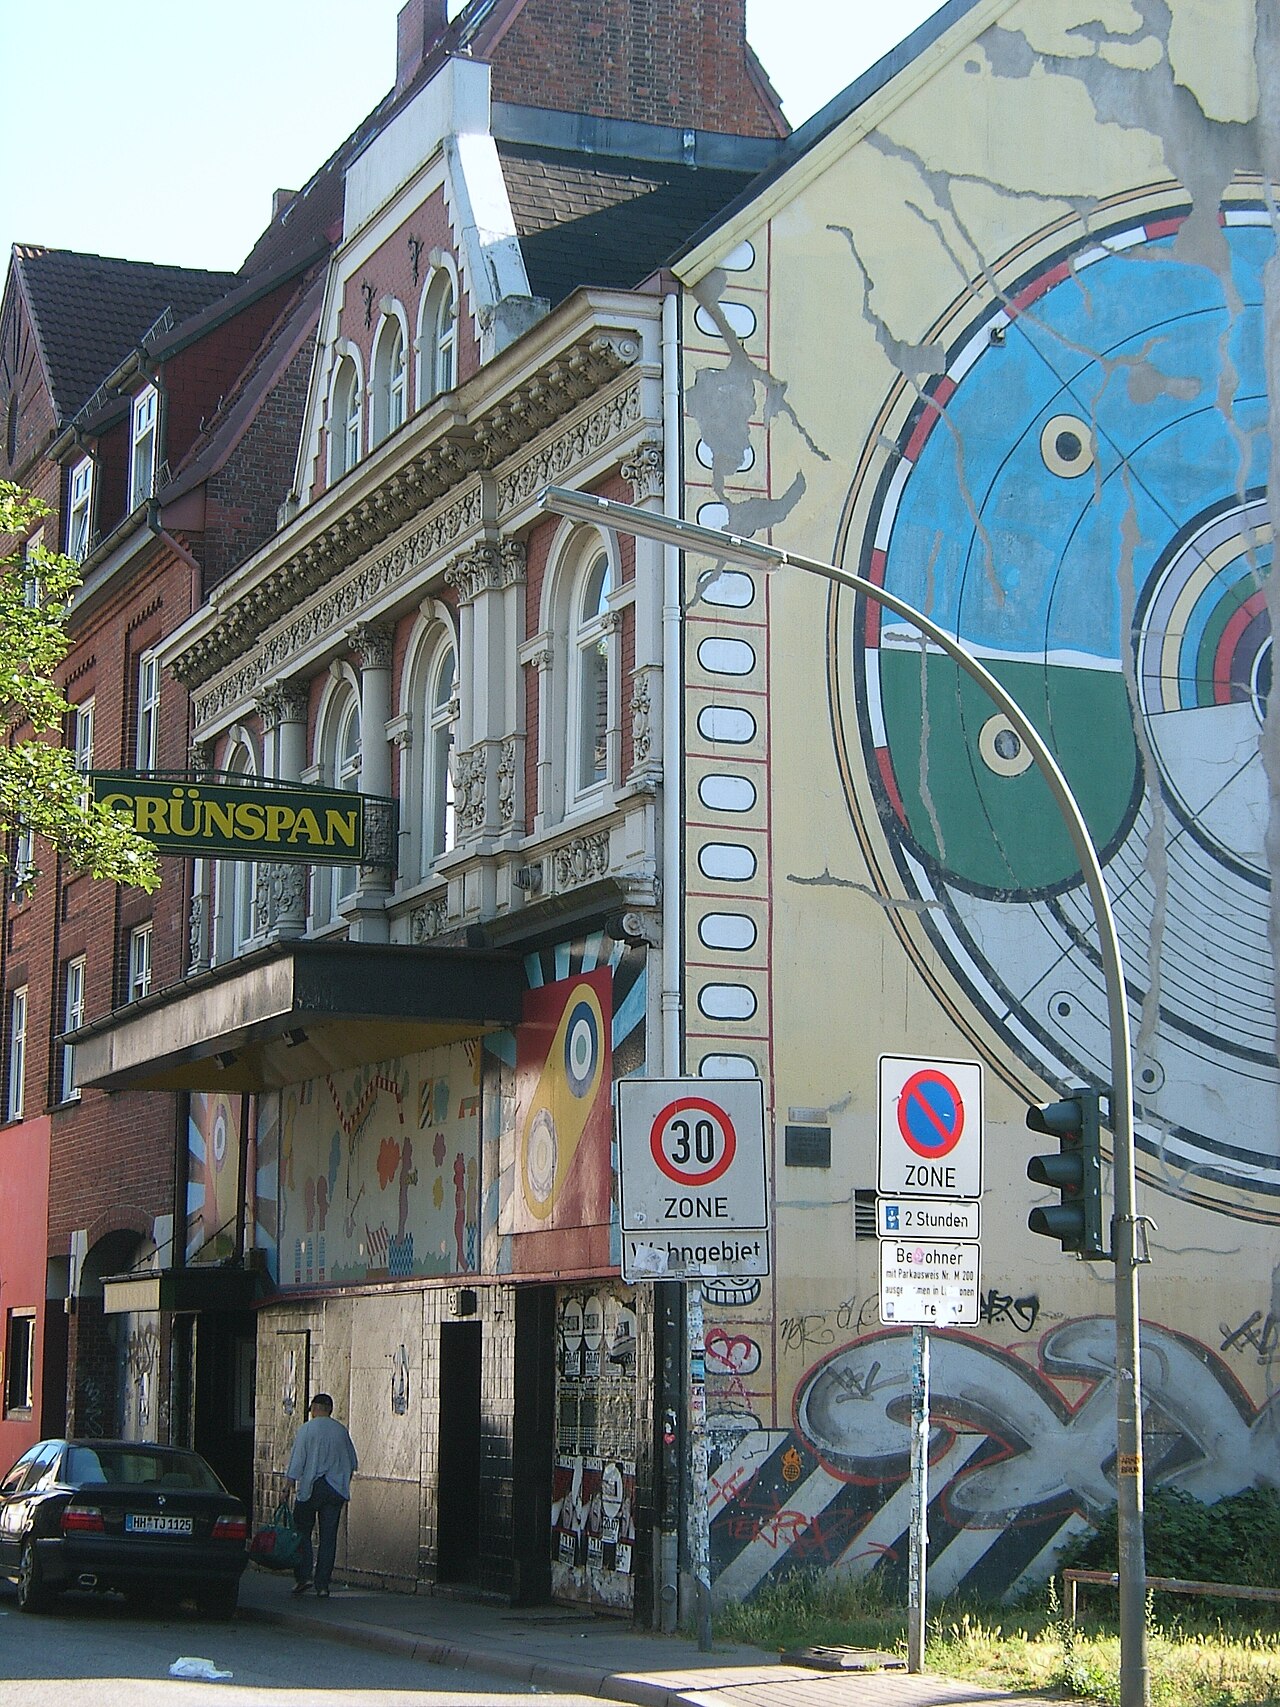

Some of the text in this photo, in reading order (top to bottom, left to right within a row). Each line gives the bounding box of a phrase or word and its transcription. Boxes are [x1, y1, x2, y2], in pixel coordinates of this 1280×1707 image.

[671, 1119, 714, 1164] 30
[905, 1165, 956, 1188] ZONE
[664, 1197, 728, 1219] ZONE
[905, 1211, 968, 1227] 2 Stunden
[631, 1240, 761, 1265] hngebiet
[896, 1247, 963, 1265] Beohner
[886, 1269, 897, 1279] mit
[898, 1268, 940, 1280] Parkausweis
[954, 1270, 960, 1280] M
[962, 1270, 974, 1281] 200
[932, 1284, 939, 1296] in
[133, 1516, 191, 1531] HH TJ 1125
[603, 1519, 619, 1533] 20.07
